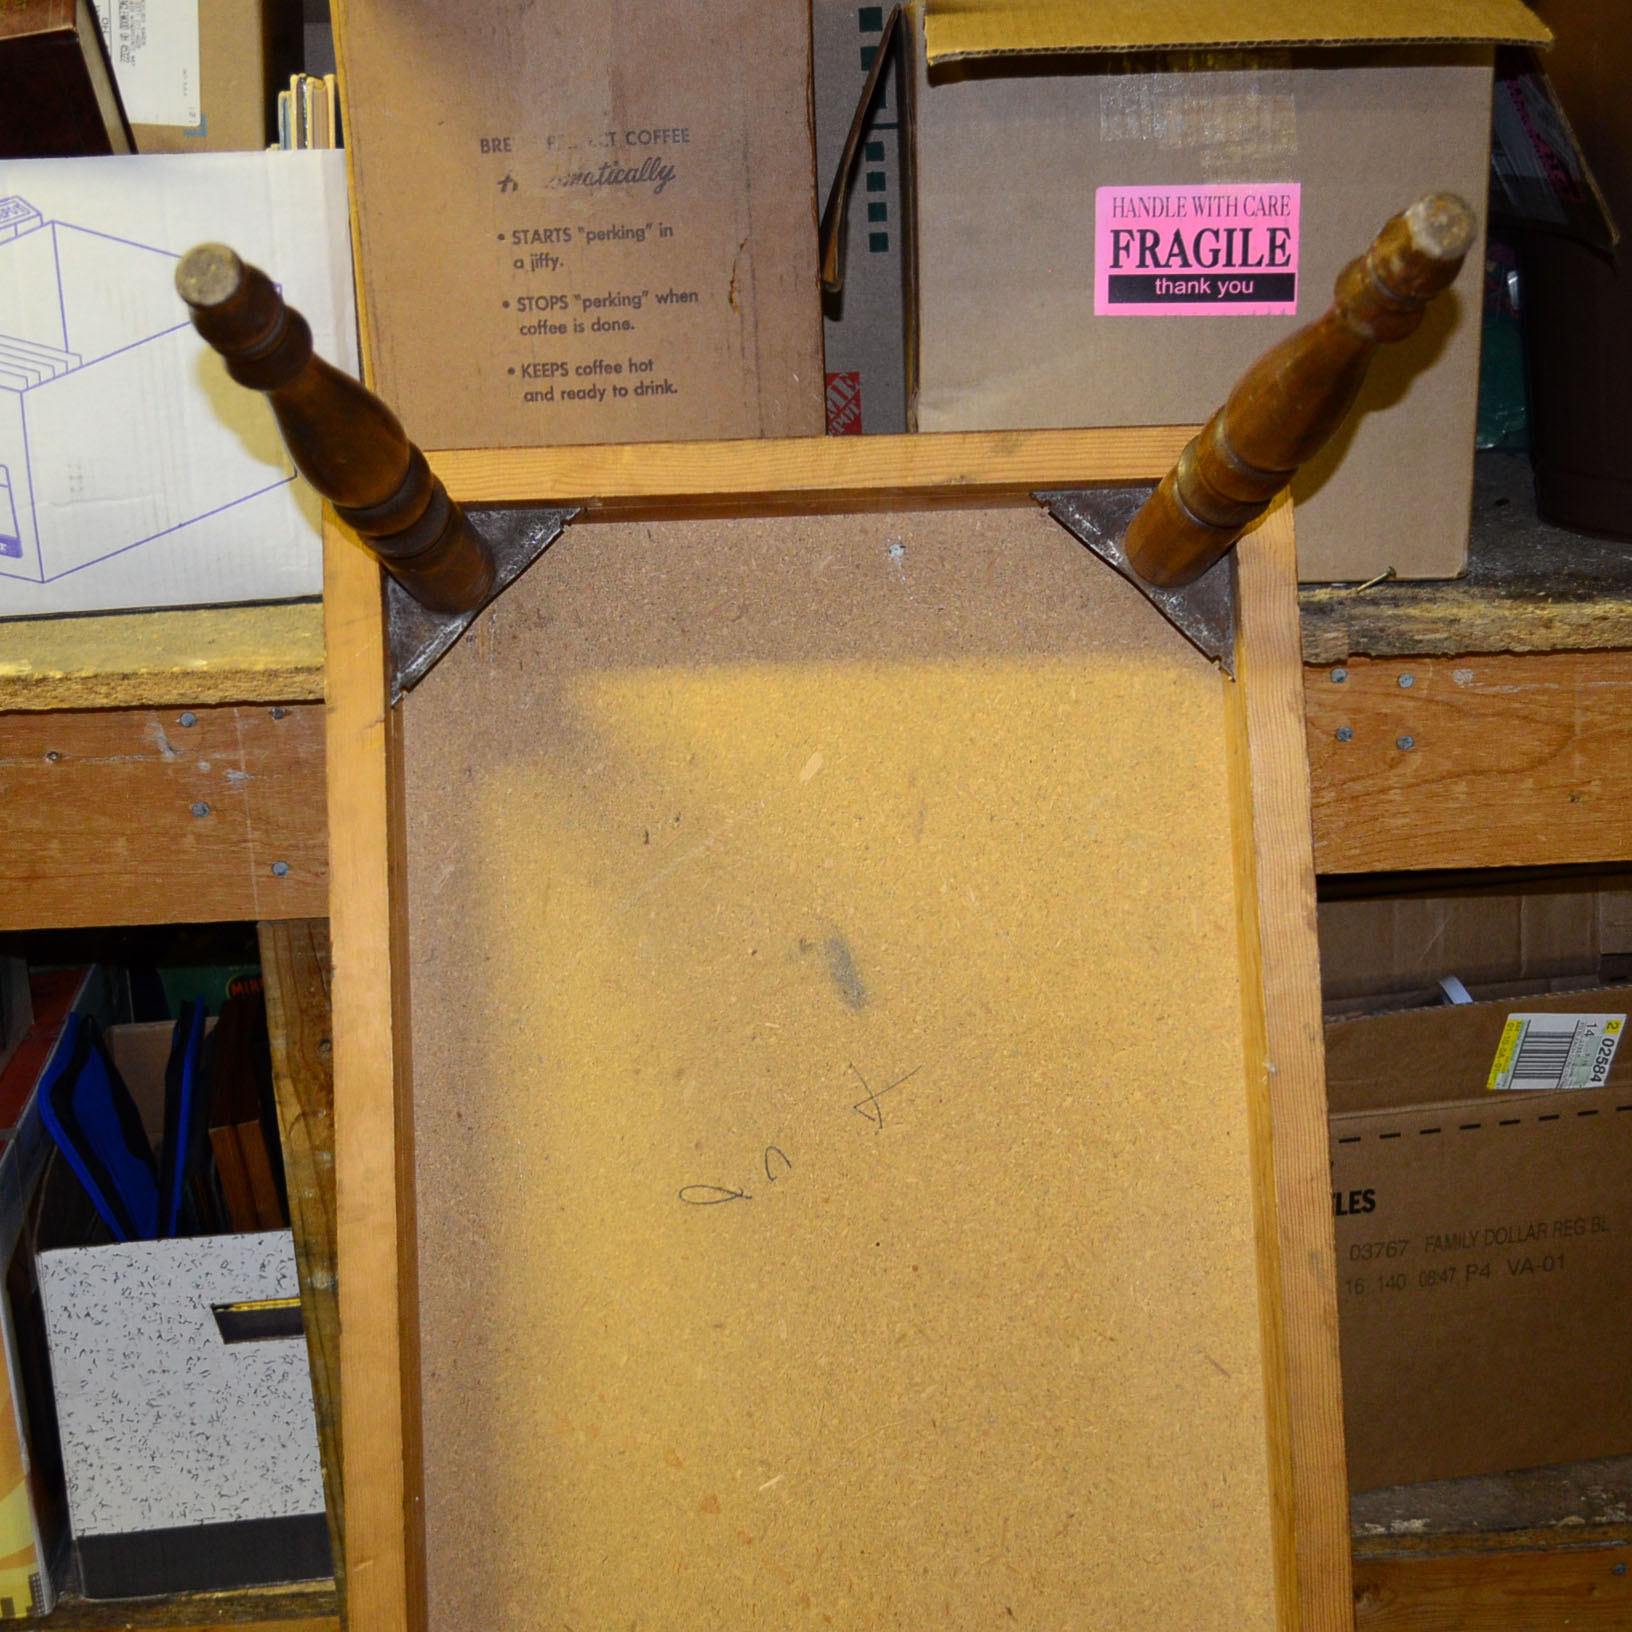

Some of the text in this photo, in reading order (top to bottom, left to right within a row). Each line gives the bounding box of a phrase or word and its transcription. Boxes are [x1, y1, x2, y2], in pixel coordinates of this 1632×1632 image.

[480, 136, 513, 154] BRE
[625, 127, 690, 146] COFFEE
[1112, 194, 1291, 219] HANDLE WITH CARE
[512, 227, 572, 245] STARTS
[659, 222, 674, 237] in
[1109, 226, 1292, 269] FRAGILE
[513, 252, 564, 272] a jiffy.
[1155, 277, 1254, 298] thank you
[517, 295, 569, 312] STOPS
[655, 288, 698, 303] when
[520, 316, 635, 336] coffee is done.
[521, 357, 654, 378] KEEPS coffee hot
[524, 379, 678, 402] and ready to drink.
[1589, 1037, 1615, 1083] 02584
[1332, 1189, 1376, 1216] LES
[1350, 1239, 1409, 1261] 03767
[1425, 1230, 1480, 1253] FAMILY
[1484, 1222, 1547, 1247] DOLLAR
[1553, 1217, 1586, 1238] REG
[1465, 1262, 1491, 1282] P4
[1506, 1253, 1566, 1276] VA-01
